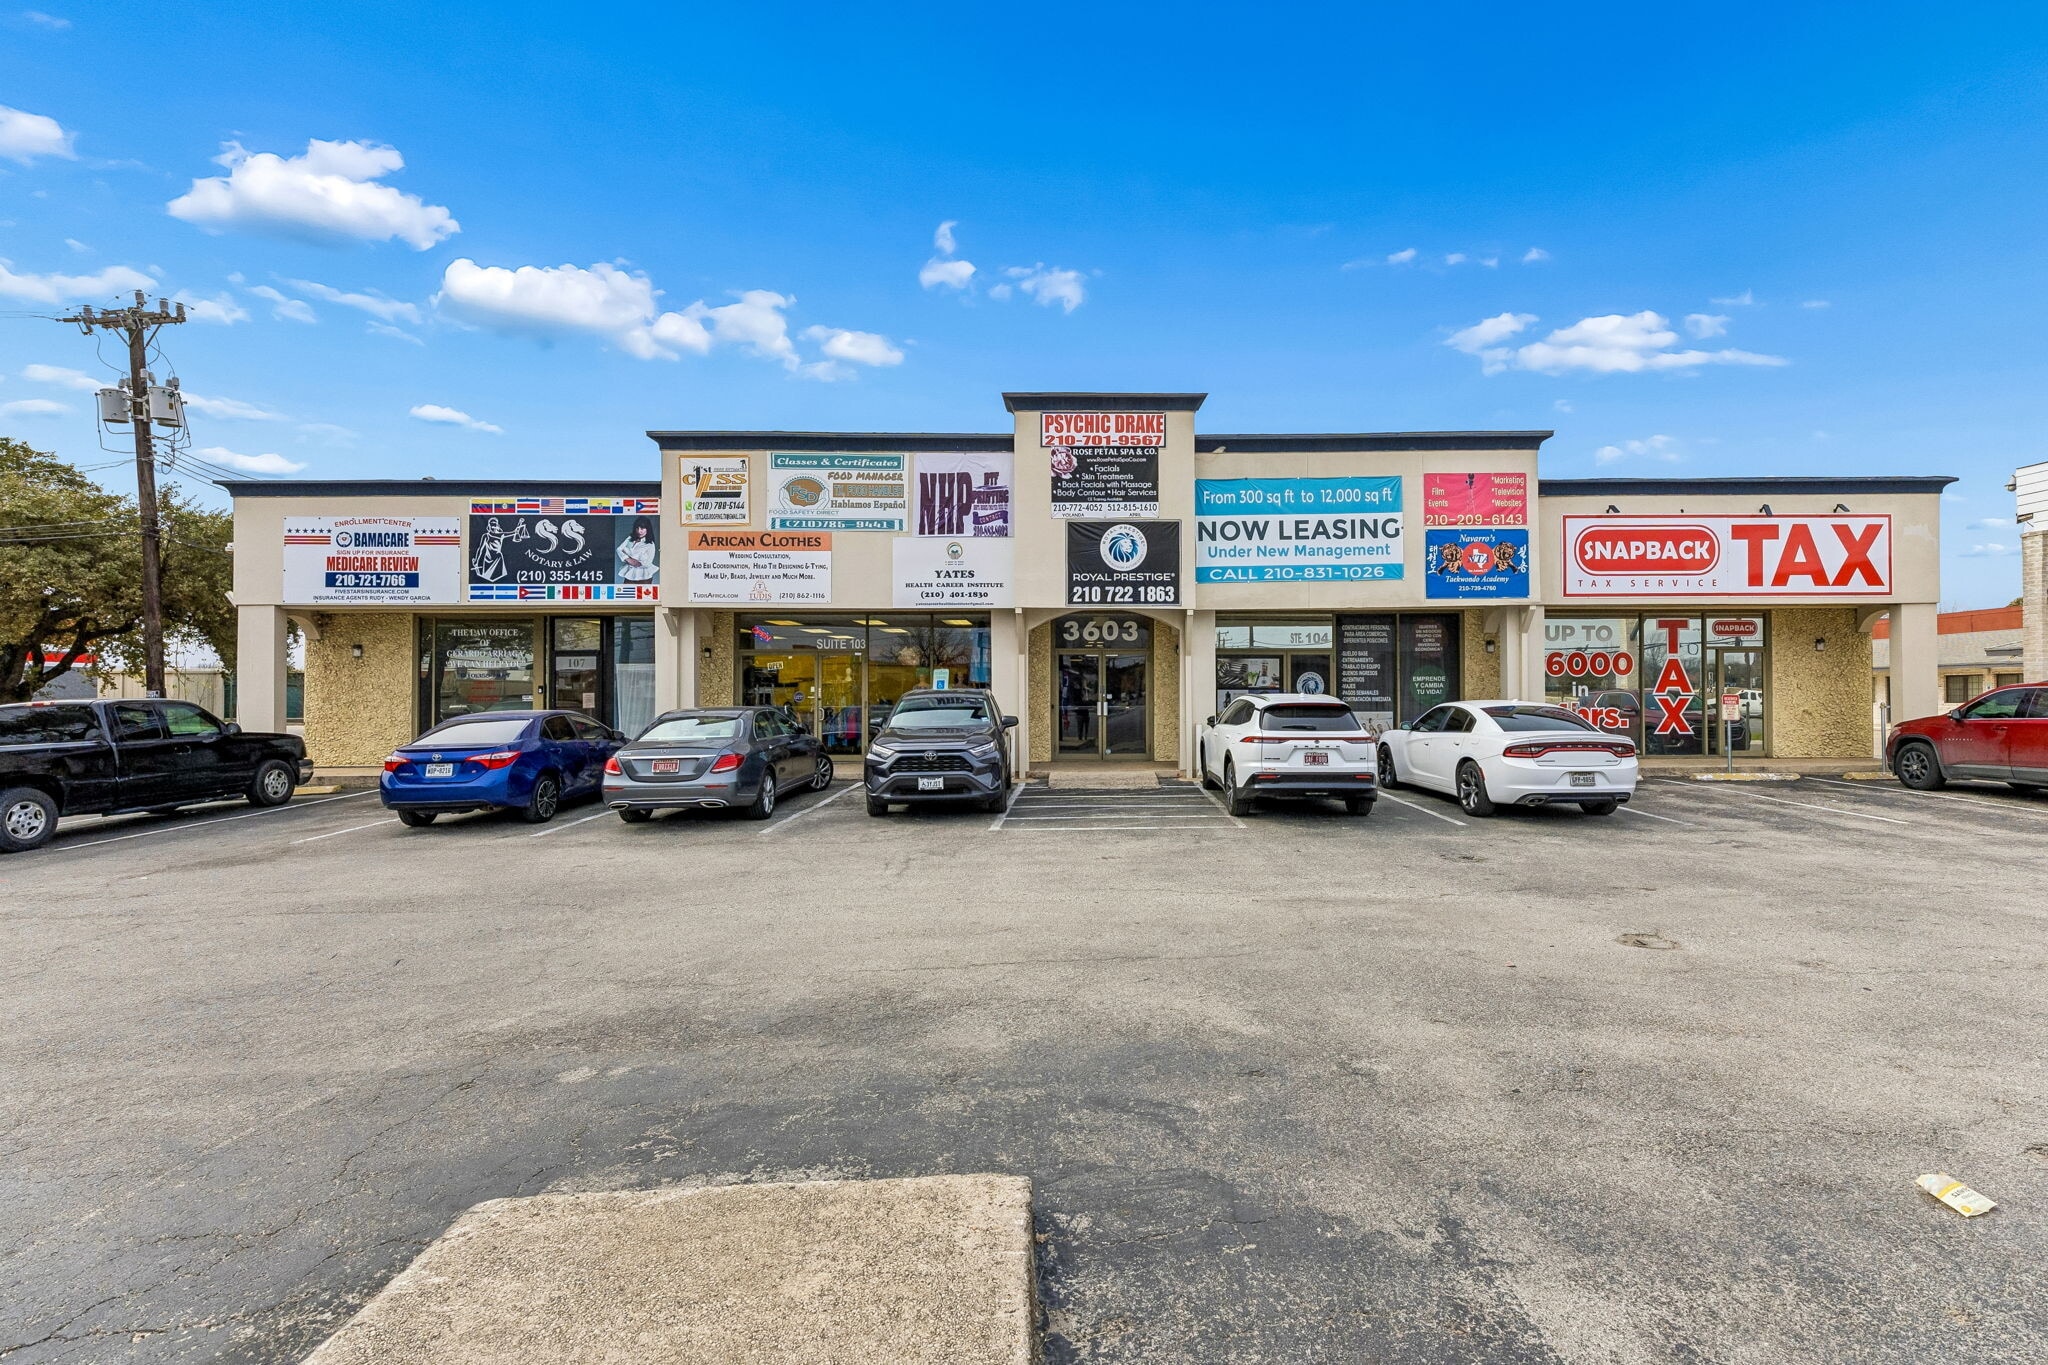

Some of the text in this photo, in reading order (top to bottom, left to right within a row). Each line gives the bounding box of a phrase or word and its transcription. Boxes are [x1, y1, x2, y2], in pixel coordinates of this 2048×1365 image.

[1044, 415, 1164, 433] PSYCHIC DRAKE
[1044, 436, 1162, 446] 210-701-9567
[834, 458, 898, 467] Certificates
[828, 472, 903, 481] FOOD MANAGER
[1057, 489, 1076, 497] Body
[1203, 488, 1392, 506] From 300 sq ft to 12,000 sq ft
[830, 500, 906, 511] Hablamos Español
[918, 472, 973, 535] NHP
[334, 518, 412, 528] ENROLLMENT CENTER
[1426, 514, 1522, 525] 210-209-6143
[1198, 518, 1400, 542] NOW LEASING
[1459, 534, 1495, 542] Navarro's
[1208, 543, 1390, 559] Under New Management
[1584, 541, 1710, 560] SNAPBACK
[1731, 523, 1885, 587] TAX
[326, 557, 419, 571] MEDICARE REVIEW
[525, 549, 564, 567] NOTARY
[573, 549, 593, 565] LAW
[336, 574, 406, 586] 210-721-7766
[517, 570, 603, 583] (210) 355-1415
[935, 570, 975, 578] YATES
[1210, 567, 1385, 580] CALL 210-831-1026
[921, 591, 944, 599] (210)
[1073, 586, 1175, 602] 210 722 1863
[1063, 620, 1138, 640] 3603
[1545, 625, 1613, 641] UP TO
[817, 639, 866, 649] SUITE 103
[1290, 633, 1328, 643] STE. 104
[568, 659, 585, 667] 107
[1545, 651, 1634, 677] 6000
[1653, 618, 1694, 735] TAX
[1572, 682, 1588, 696] in
